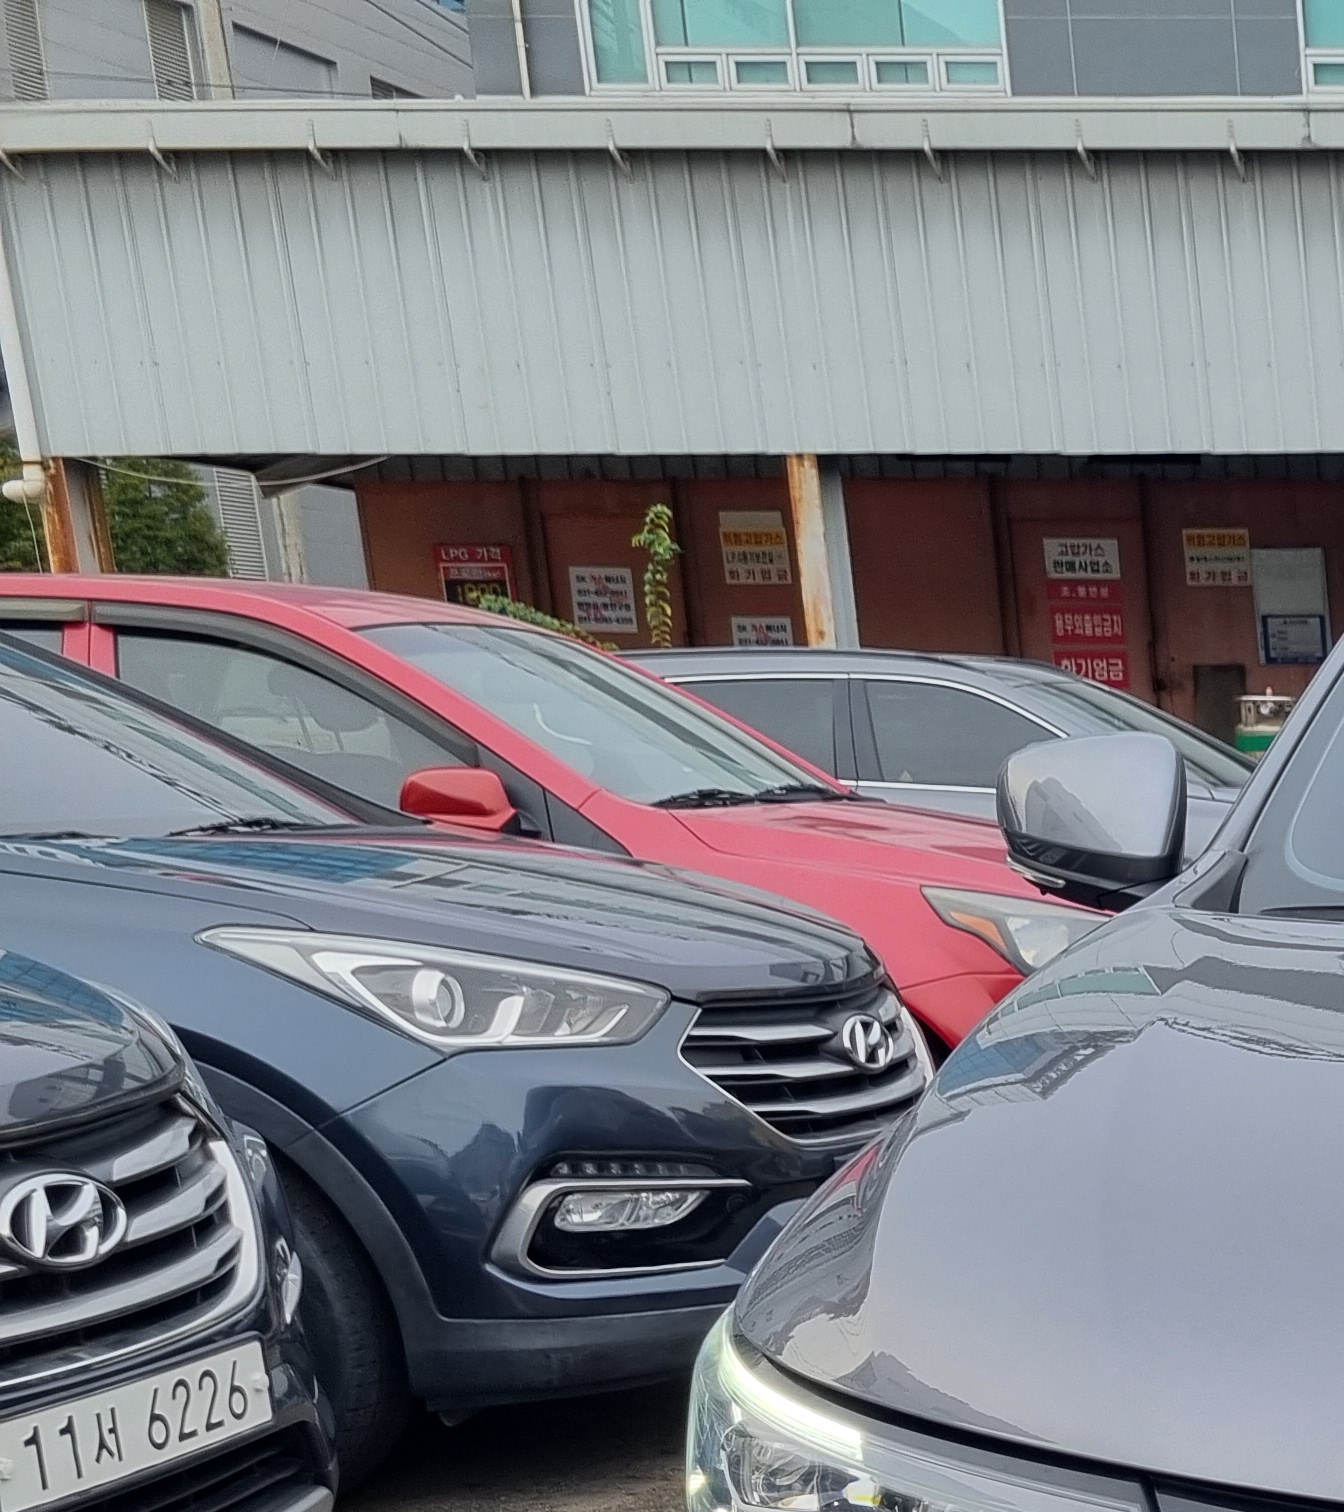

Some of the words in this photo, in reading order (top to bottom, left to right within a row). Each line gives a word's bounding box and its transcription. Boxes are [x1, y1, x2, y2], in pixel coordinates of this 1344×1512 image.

[441, 547, 469, 561] LPG
[1057, 542, 1105, 557] 고압가스
[1052, 559, 1113, 574] 판매사업소
[23, 1406, 124, 1491] 11서
[147, 1359, 249, 1451] 6226
